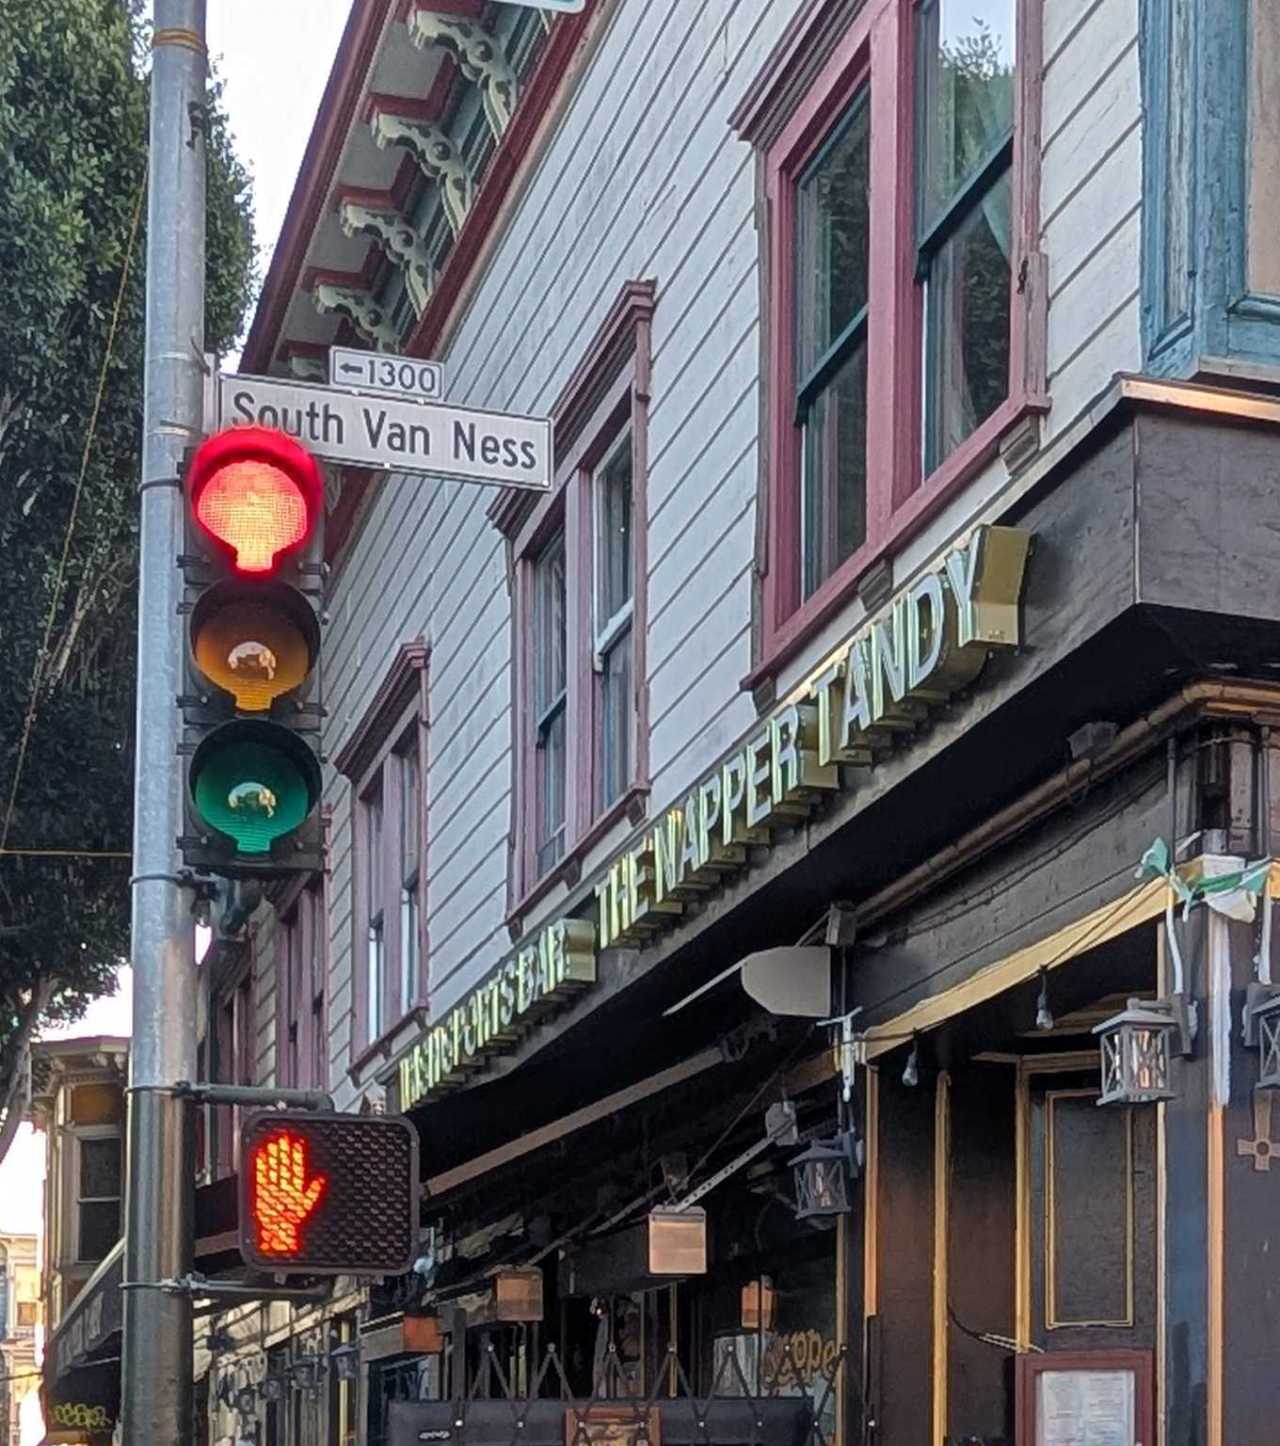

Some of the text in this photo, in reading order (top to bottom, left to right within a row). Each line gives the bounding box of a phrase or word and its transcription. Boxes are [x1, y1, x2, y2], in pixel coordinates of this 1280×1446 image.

[369, 359, 436, 393] 1300
[231, 391, 537, 470] South Van Ness
[440, 961, 516, 1074] SPORTS
[517, 924, 569, 1014] BAR
[594, 836, 656, 950] THE
[654, 704, 802, 903] NAPPER
[811, 526, 984, 768] TANDY
